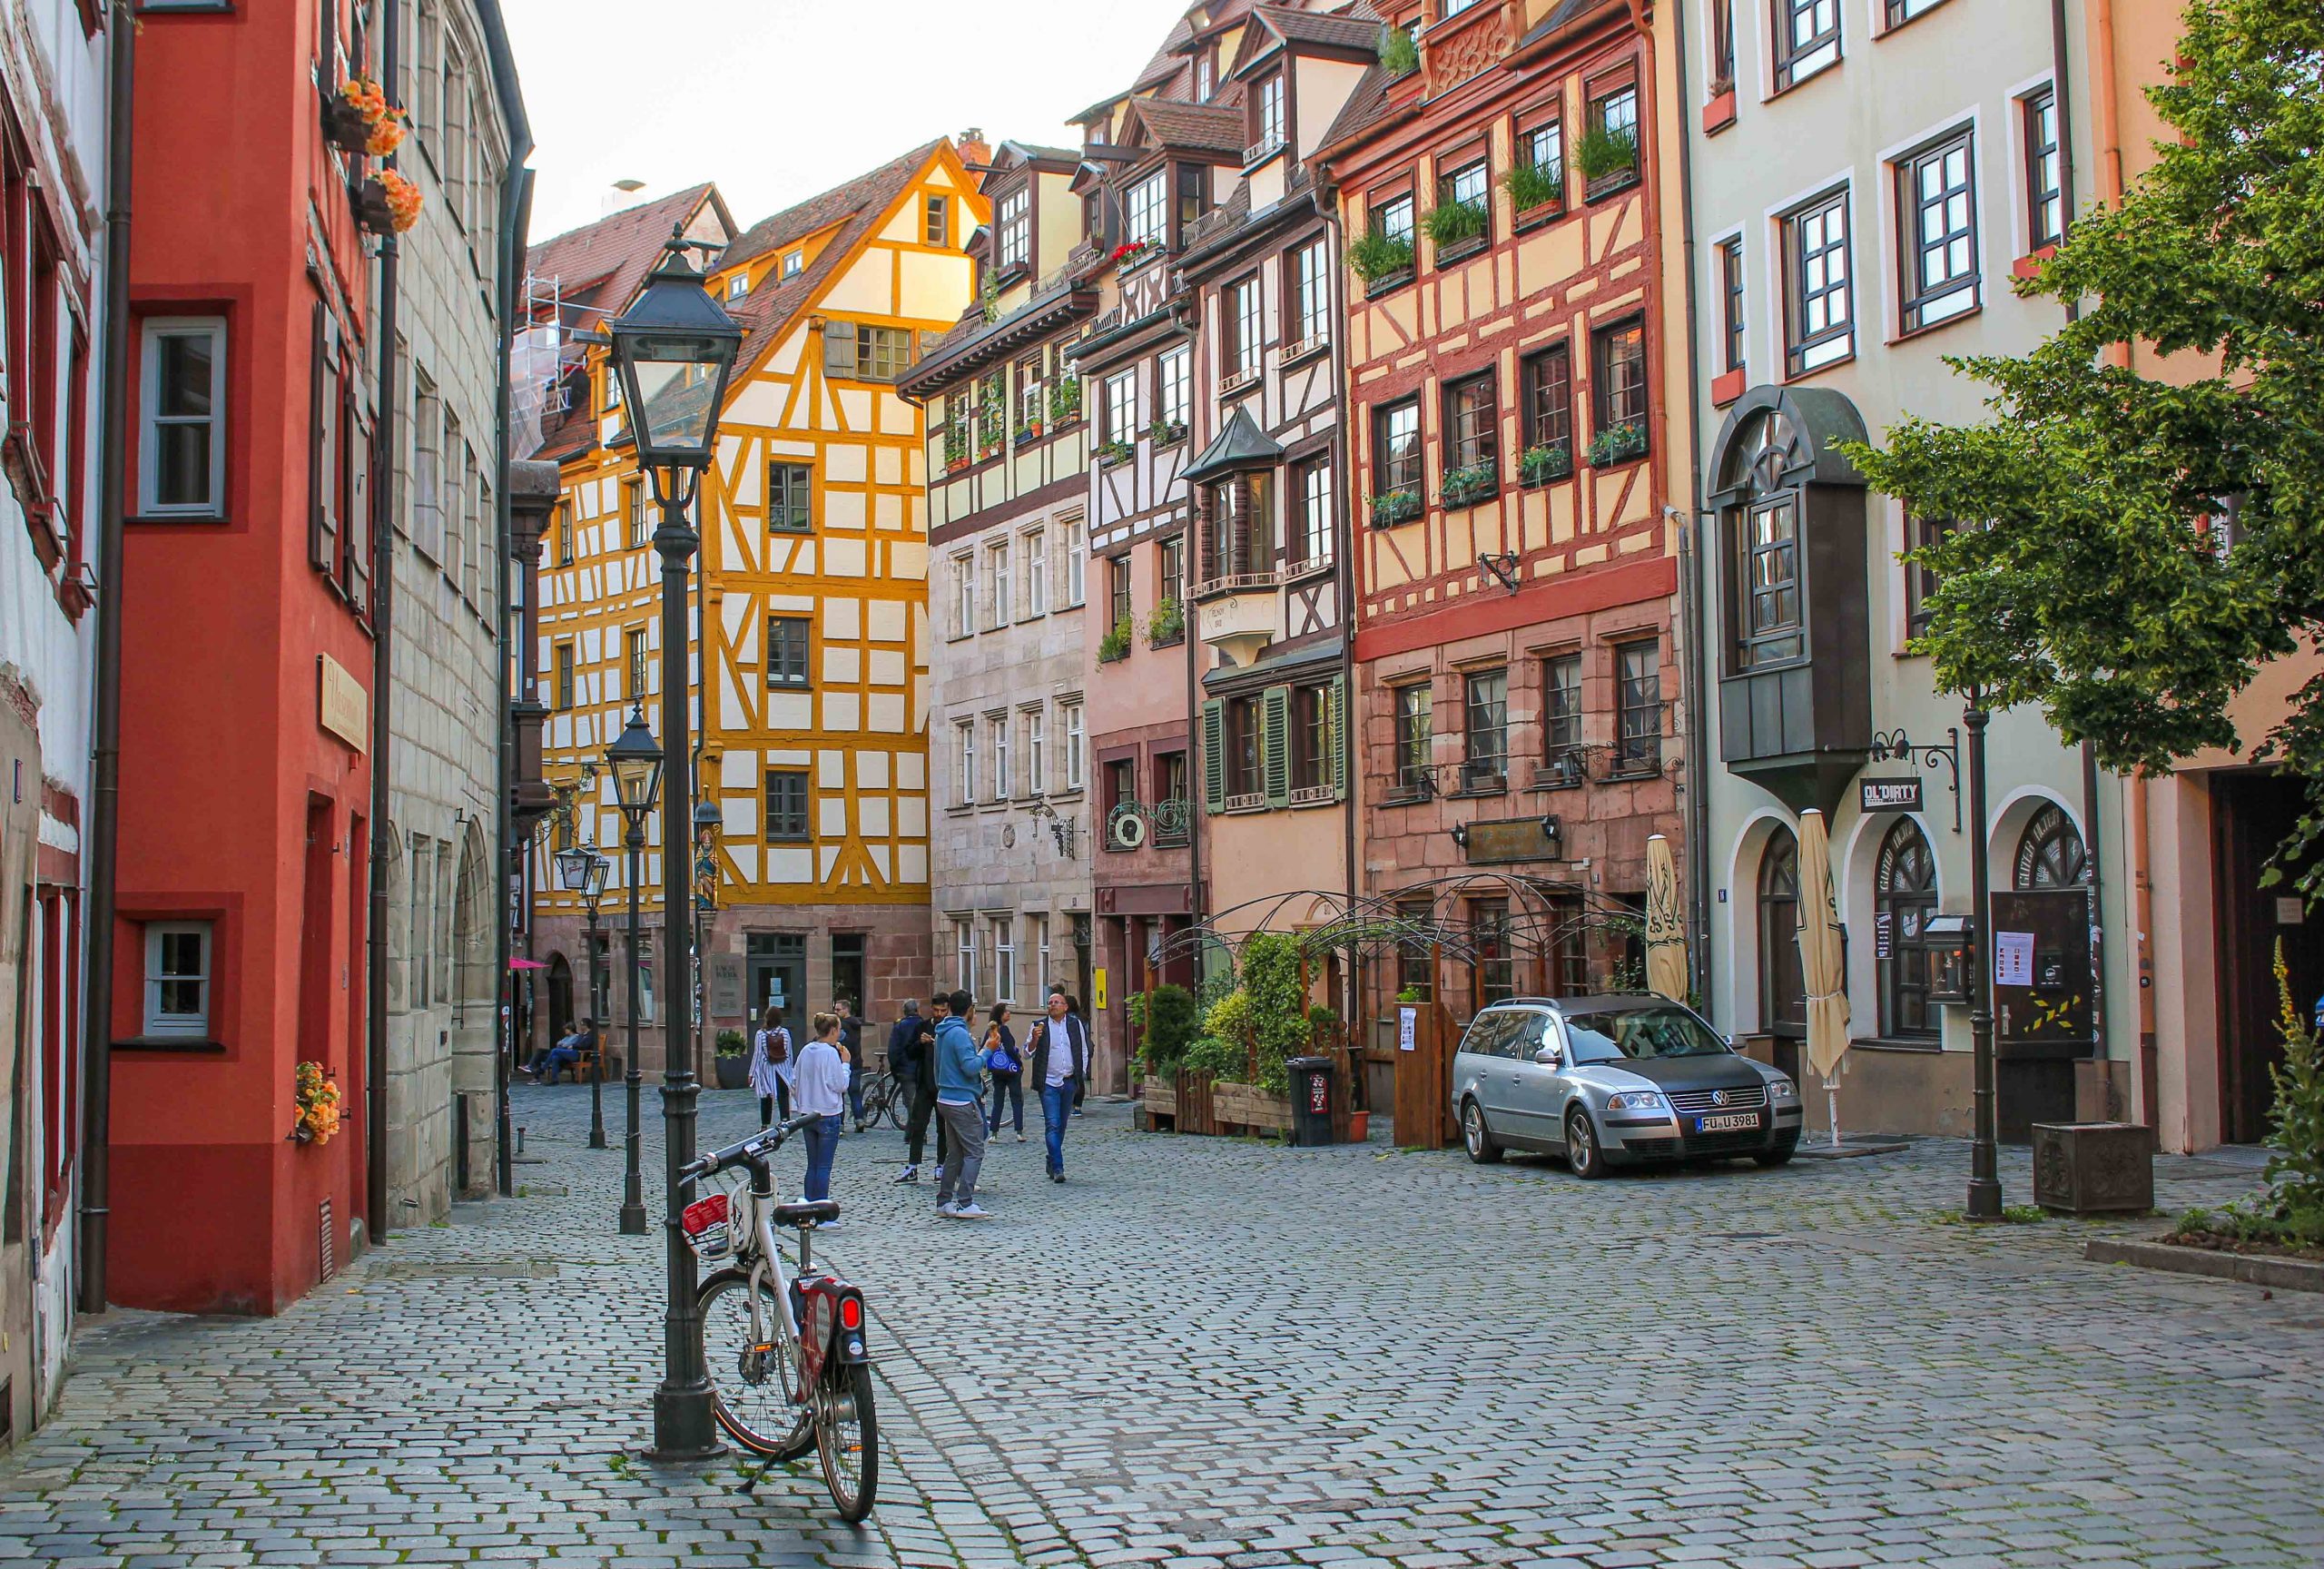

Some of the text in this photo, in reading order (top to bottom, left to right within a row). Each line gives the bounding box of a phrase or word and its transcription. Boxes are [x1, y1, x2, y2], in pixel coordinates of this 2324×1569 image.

[1703, 1114, 1758, 1130] FÜ U 3981
